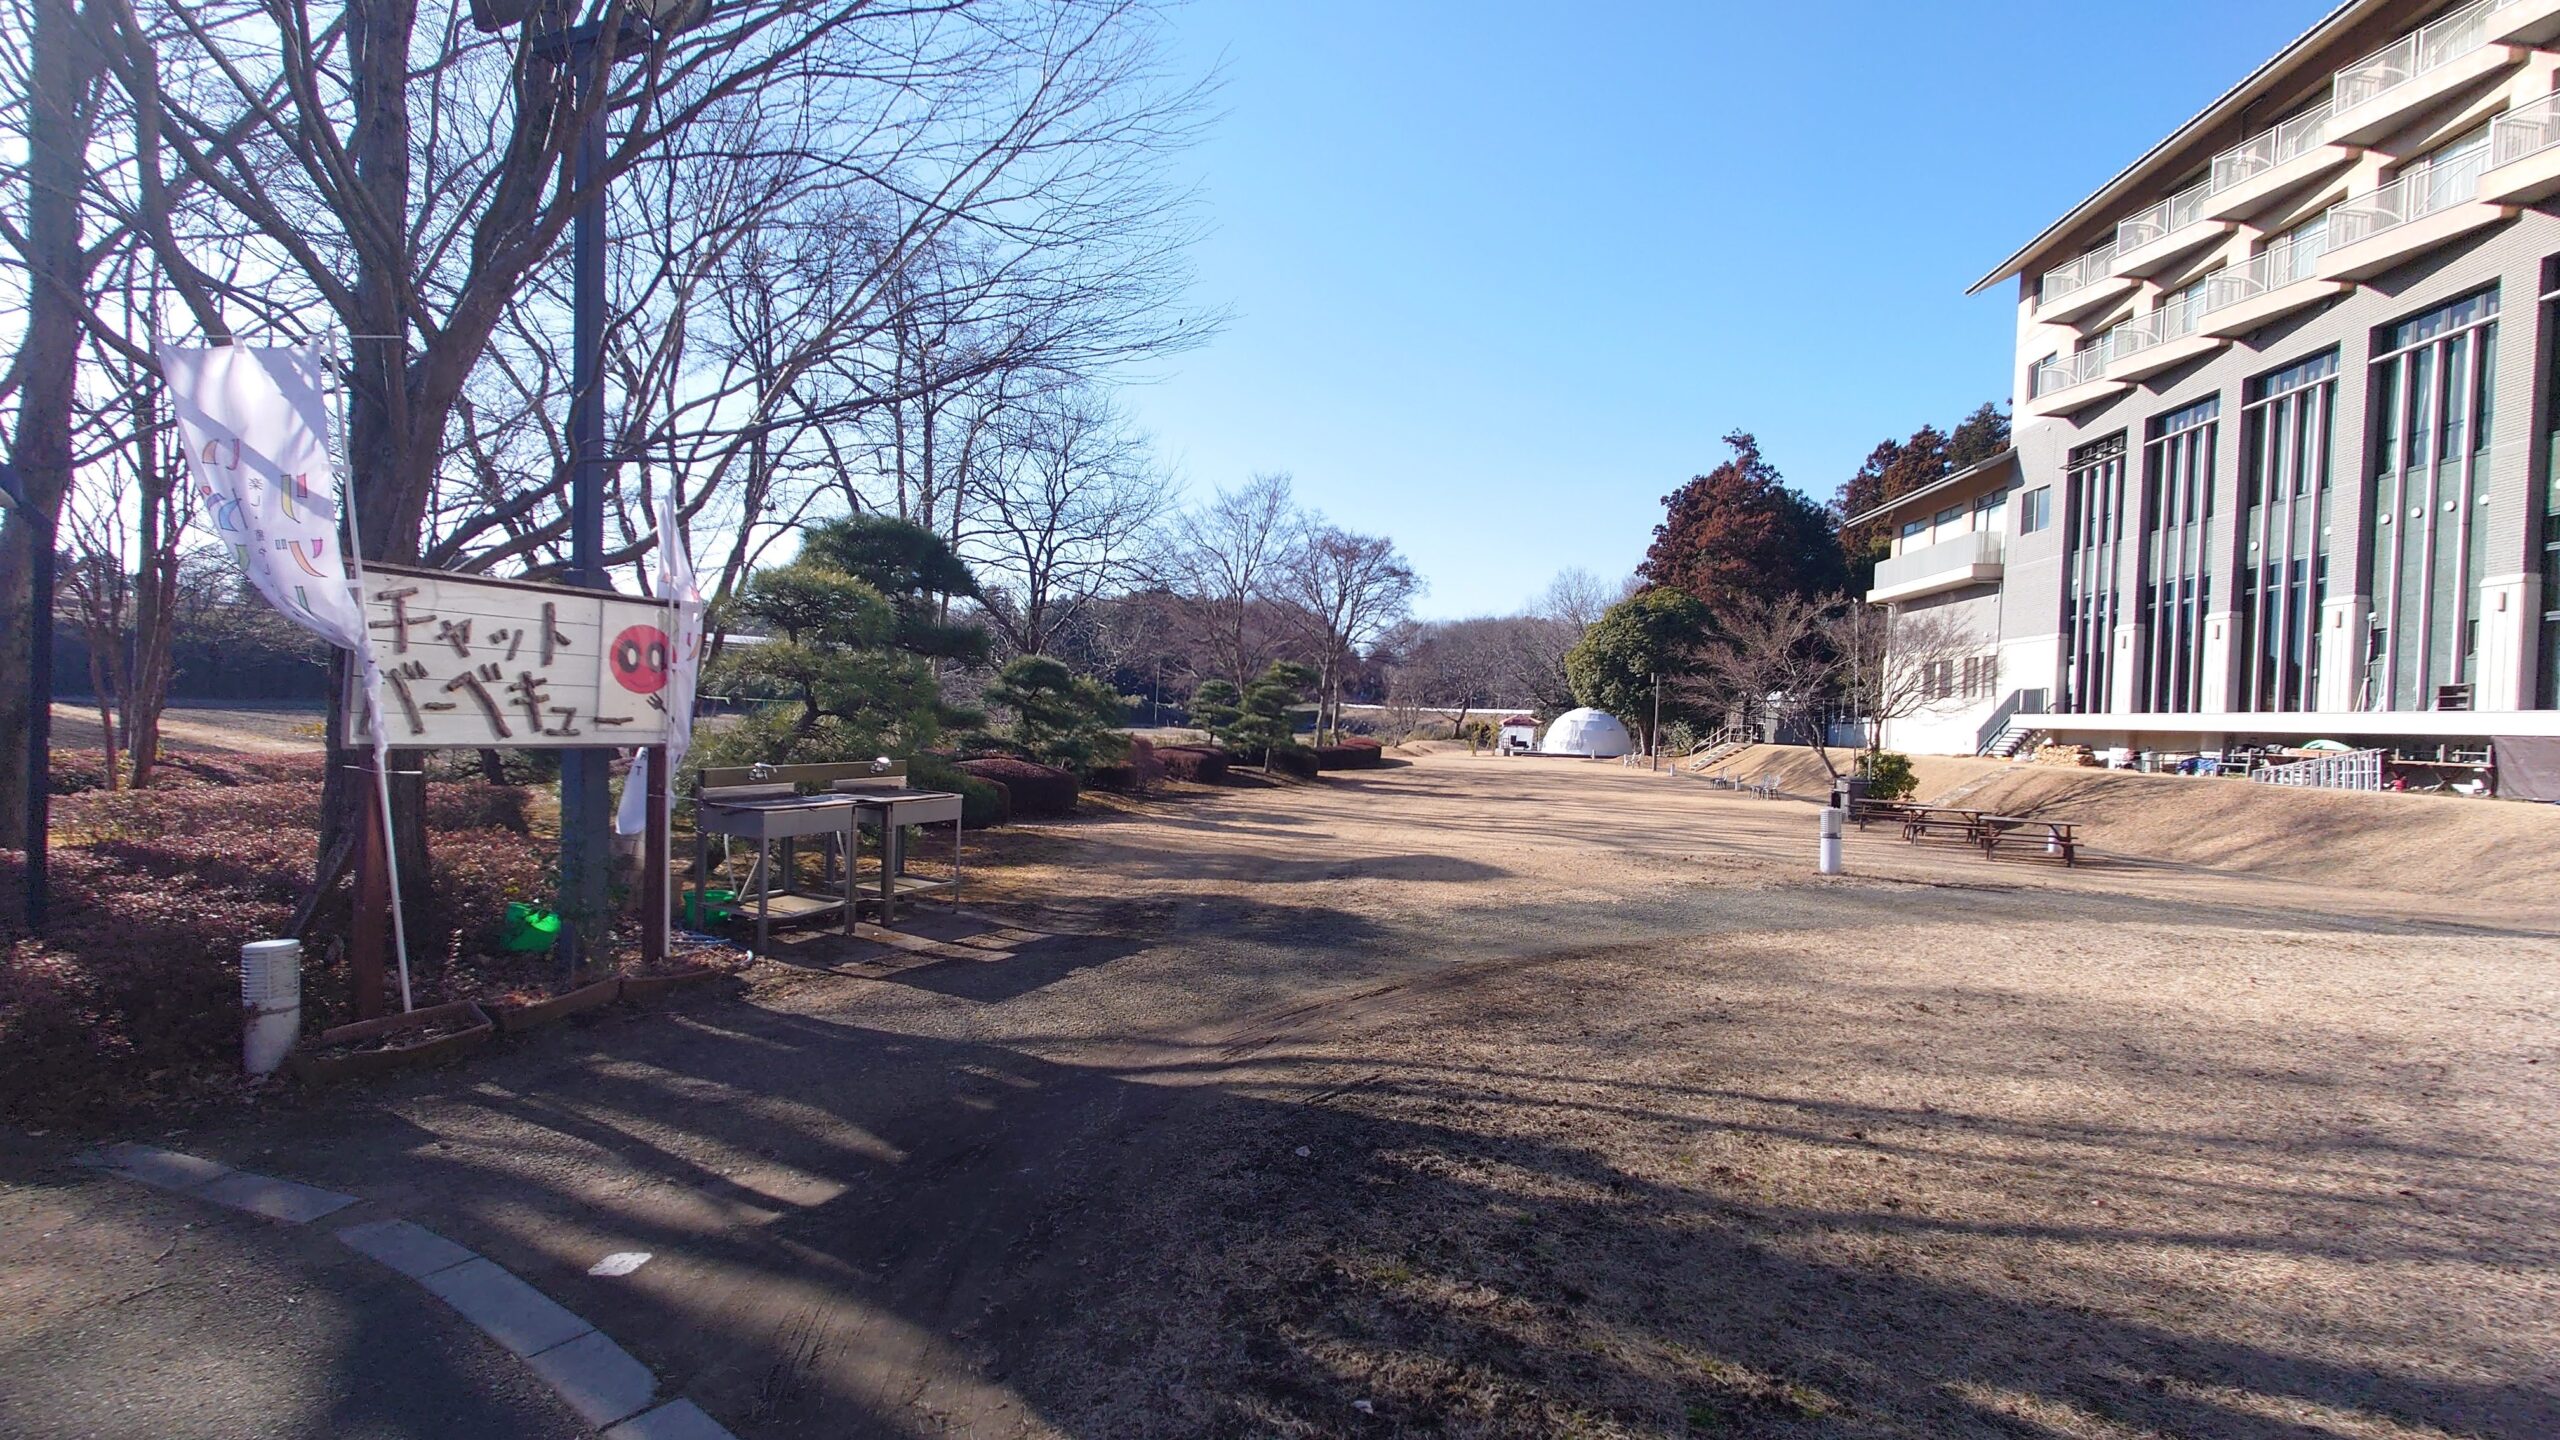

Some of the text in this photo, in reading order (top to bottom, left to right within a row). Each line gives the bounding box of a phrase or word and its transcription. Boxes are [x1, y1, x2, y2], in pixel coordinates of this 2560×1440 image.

[368, 586, 572, 666] チャット
[358, 660, 634, 738] バーベキュー
